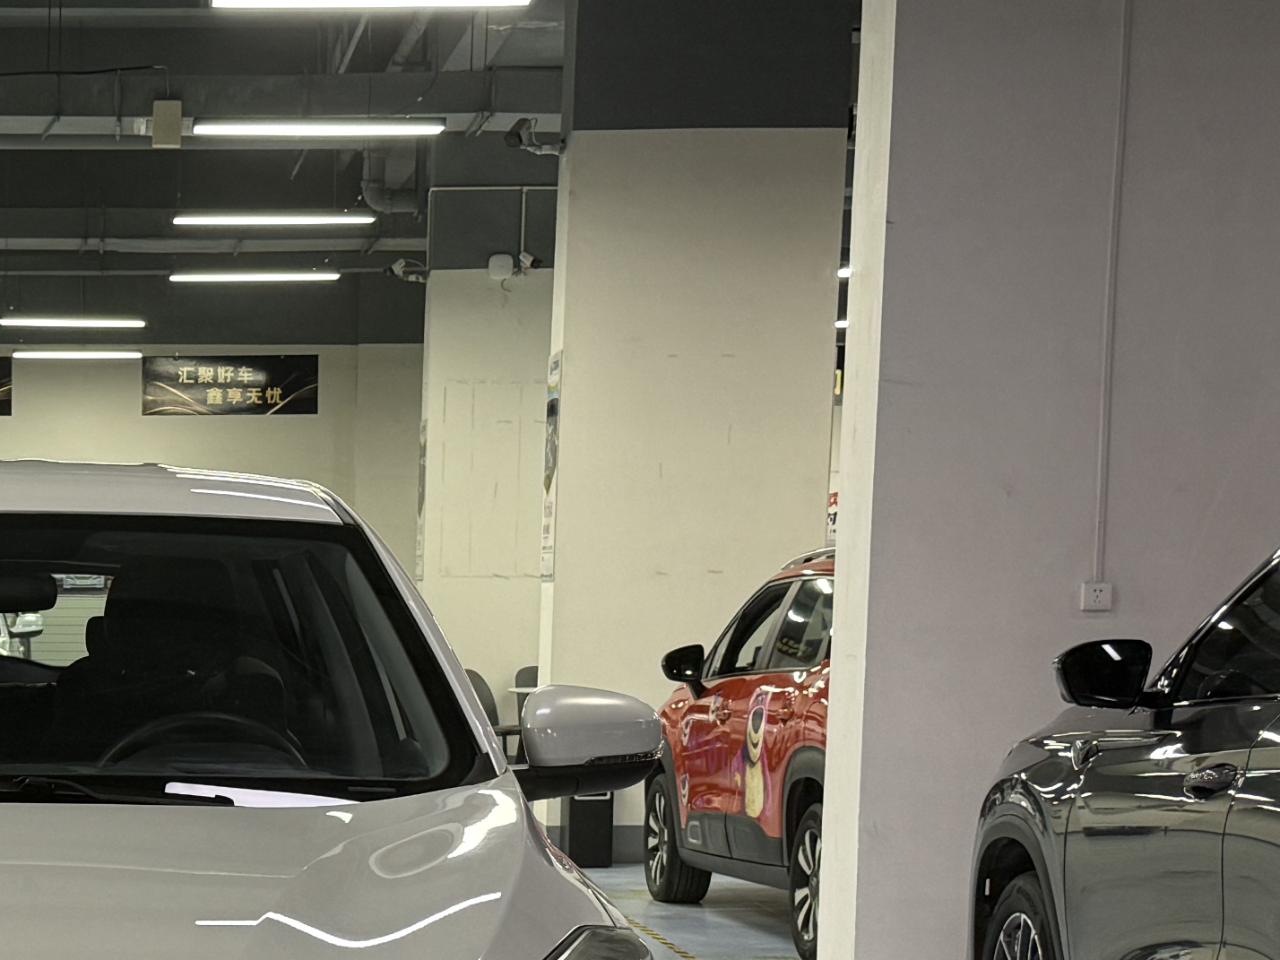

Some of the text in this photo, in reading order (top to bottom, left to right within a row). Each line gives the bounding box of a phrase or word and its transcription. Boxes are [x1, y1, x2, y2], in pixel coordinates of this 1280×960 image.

[178, 366, 253, 384] 汇聚好车
[206, 387, 283, 404] 鑫享无忧
